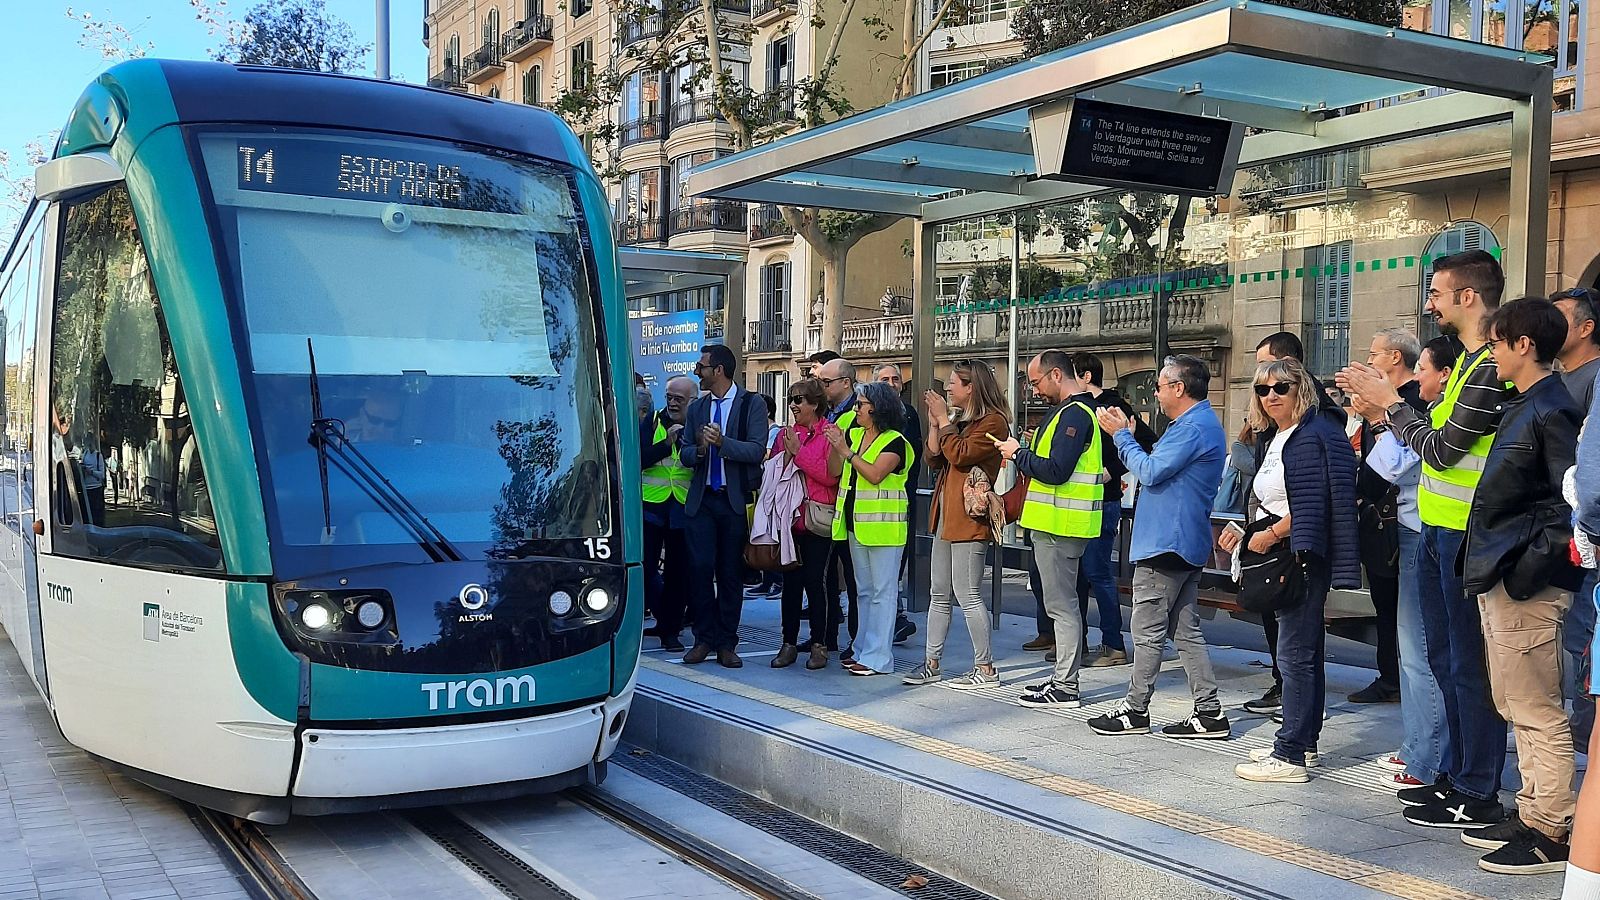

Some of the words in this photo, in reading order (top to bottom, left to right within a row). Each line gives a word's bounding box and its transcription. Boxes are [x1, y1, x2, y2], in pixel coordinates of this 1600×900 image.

[1081, 118, 1091, 128] T4
[1098, 119, 1112, 130] The
[1115, 121, 1124, 132] T4
[1126, 123, 1139, 134] line
[1141, 127, 1170, 138] extends
[1172, 130, 1184, 140] the
[1186, 133, 1211, 144] service
[1095, 131, 1103, 140] to
[1105, 132, 1144, 146] Verdaguer
[1146, 138, 1160, 148] with
[1162, 140, 1180, 151] three
[1182, 144, 1198, 153] new
[240, 146, 274, 184] T4
[437, 163, 461, 183] DE
[1091, 153, 1131, 167] Verdaguer.
[1167, 152, 1189, 163] Sicilia
[1190, 155, 1205, 165] and
[338, 174, 392, 194] SANT
[642, 325, 647, 337] El
[648, 325, 654, 337] 10
[654, 324, 662, 336] de
[663, 321, 698, 335] novembre
[641, 344, 646, 356] la
[662, 342, 669, 354] T4
[671, 340, 692, 353] arriba
[693, 342, 698, 352] a
[584, 538, 612, 559] 15
[458, 613, 493, 623] ALSTOM
[421, 674, 536, 710] Tram
